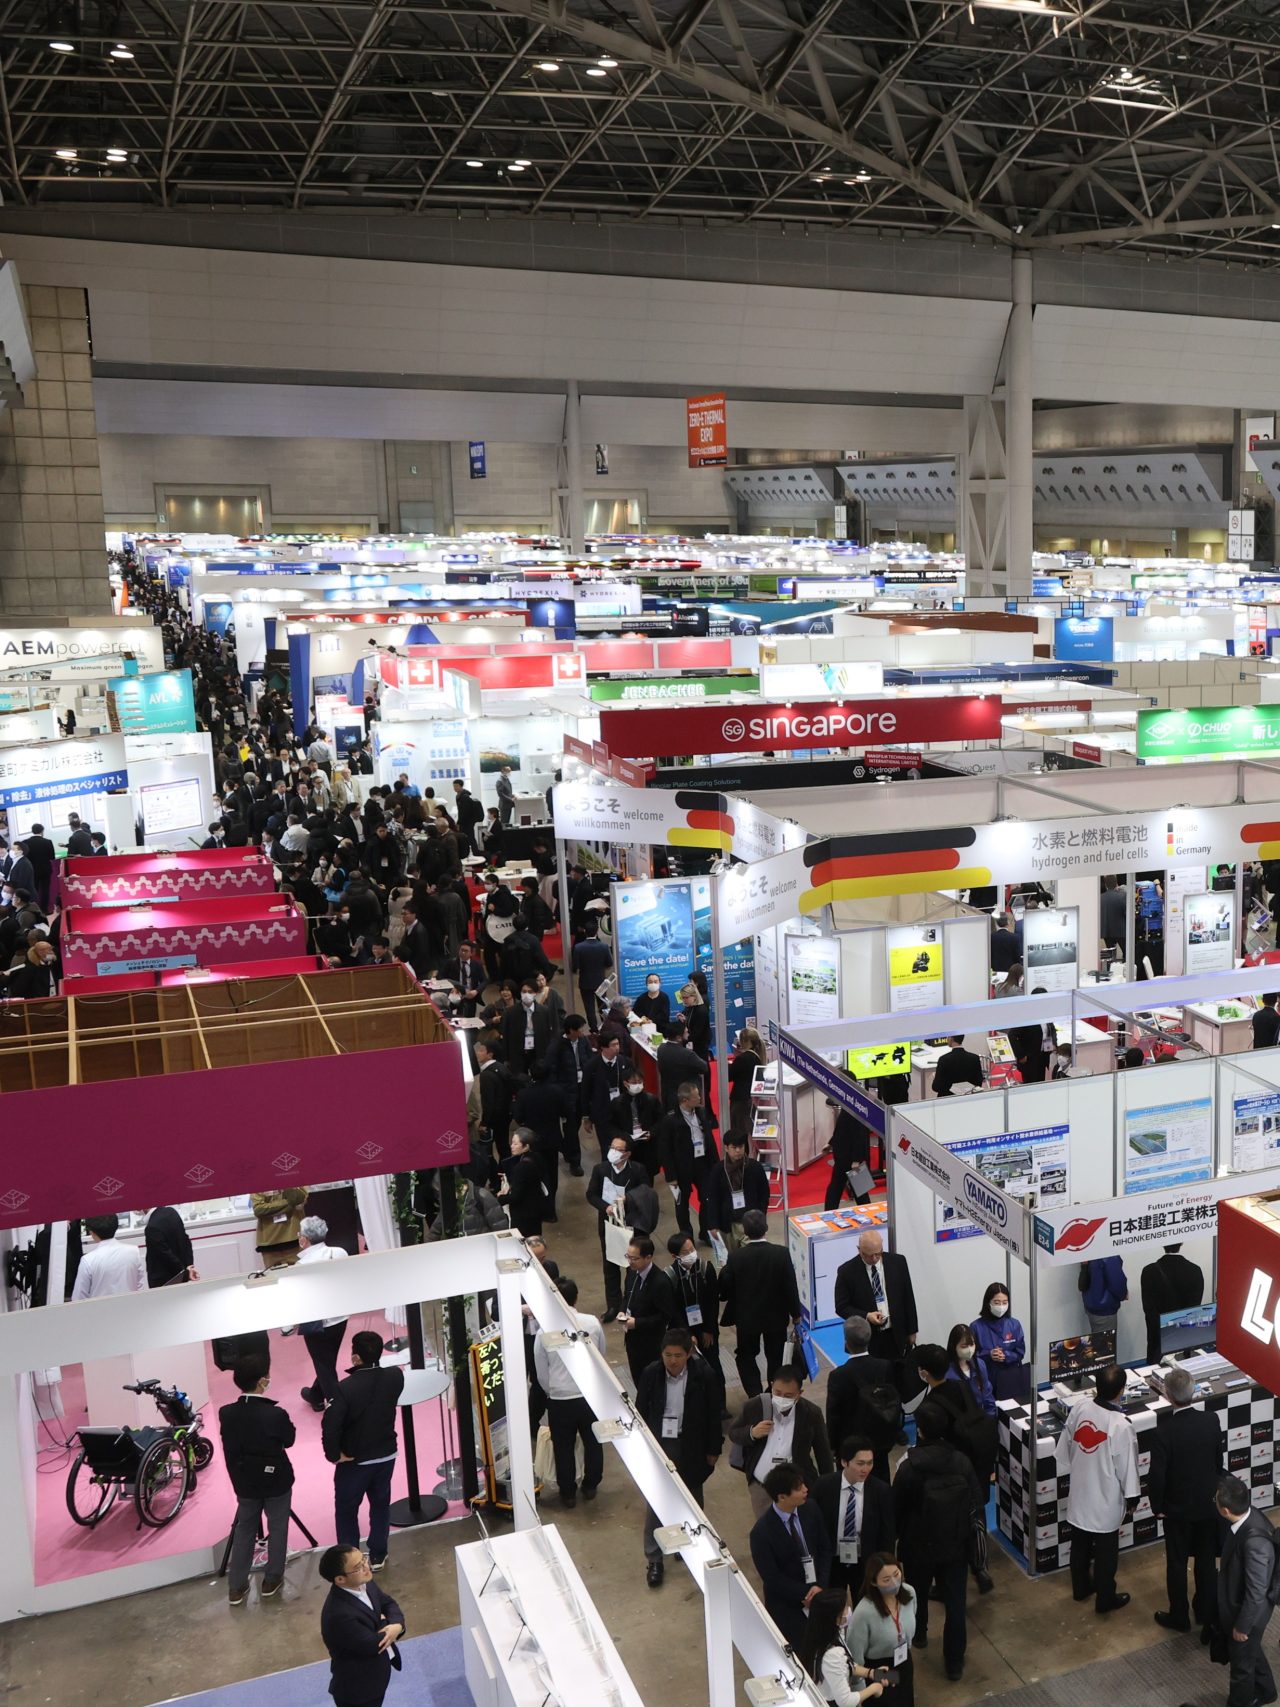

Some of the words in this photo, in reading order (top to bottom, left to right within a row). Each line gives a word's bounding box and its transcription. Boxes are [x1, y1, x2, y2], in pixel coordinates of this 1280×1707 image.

[658, 577, 717, 587] Government
[720, 577, 729, 587] of
[71, 664, 103, 672] Maximum
[103, 664, 123, 672] green
[621, 683, 705, 700] JENBACHER
[725, 724, 741, 735] SG
[869, 766, 901, 775] Sydrogen
[672, 781, 687, 789] Plate
[689, 780, 713, 789] Coating
[714, 778, 741, 787] Solutions
[573, 816, 631, 831] willkommen
[623, 809, 664, 822] welcome
[1176, 822, 1198, 833] made
[1031, 824, 1148, 851] 水素と燃料電池
[1176, 835, 1184, 844] in
[1176, 844, 1211, 856] Germany
[1031, 853, 1080, 871] hydrogen
[1082, 852, 1102, 865] and
[1104, 849, 1125, 863] fuel
[1126, 847, 1149, 861] cells
[769, 878, 797, 898] welcome
[734, 900, 775, 926] willkommen
[624, 956, 647, 969] Save
[648, 954, 663, 966] the
[665, 952, 689, 963] date!
[723, 961, 737, 971] the
[739, 959, 755, 970] dat
[779, 1038, 797, 1063] KIWA
[965, 1178, 1005, 1221] YAMATO
[1147, 1202, 1174, 1212] Future
[1175, 1199, 1184, 1207] of
[1186, 1193, 1213, 1204] Energy
[1109, 1203, 1219, 1237] 日本建設工業株式
[1112, 1220, 1213, 1247] NIHONKENSETUKOGYOU
[479, 1341, 498, 1359] 左へ
[484, 1393, 495, 1407] い
